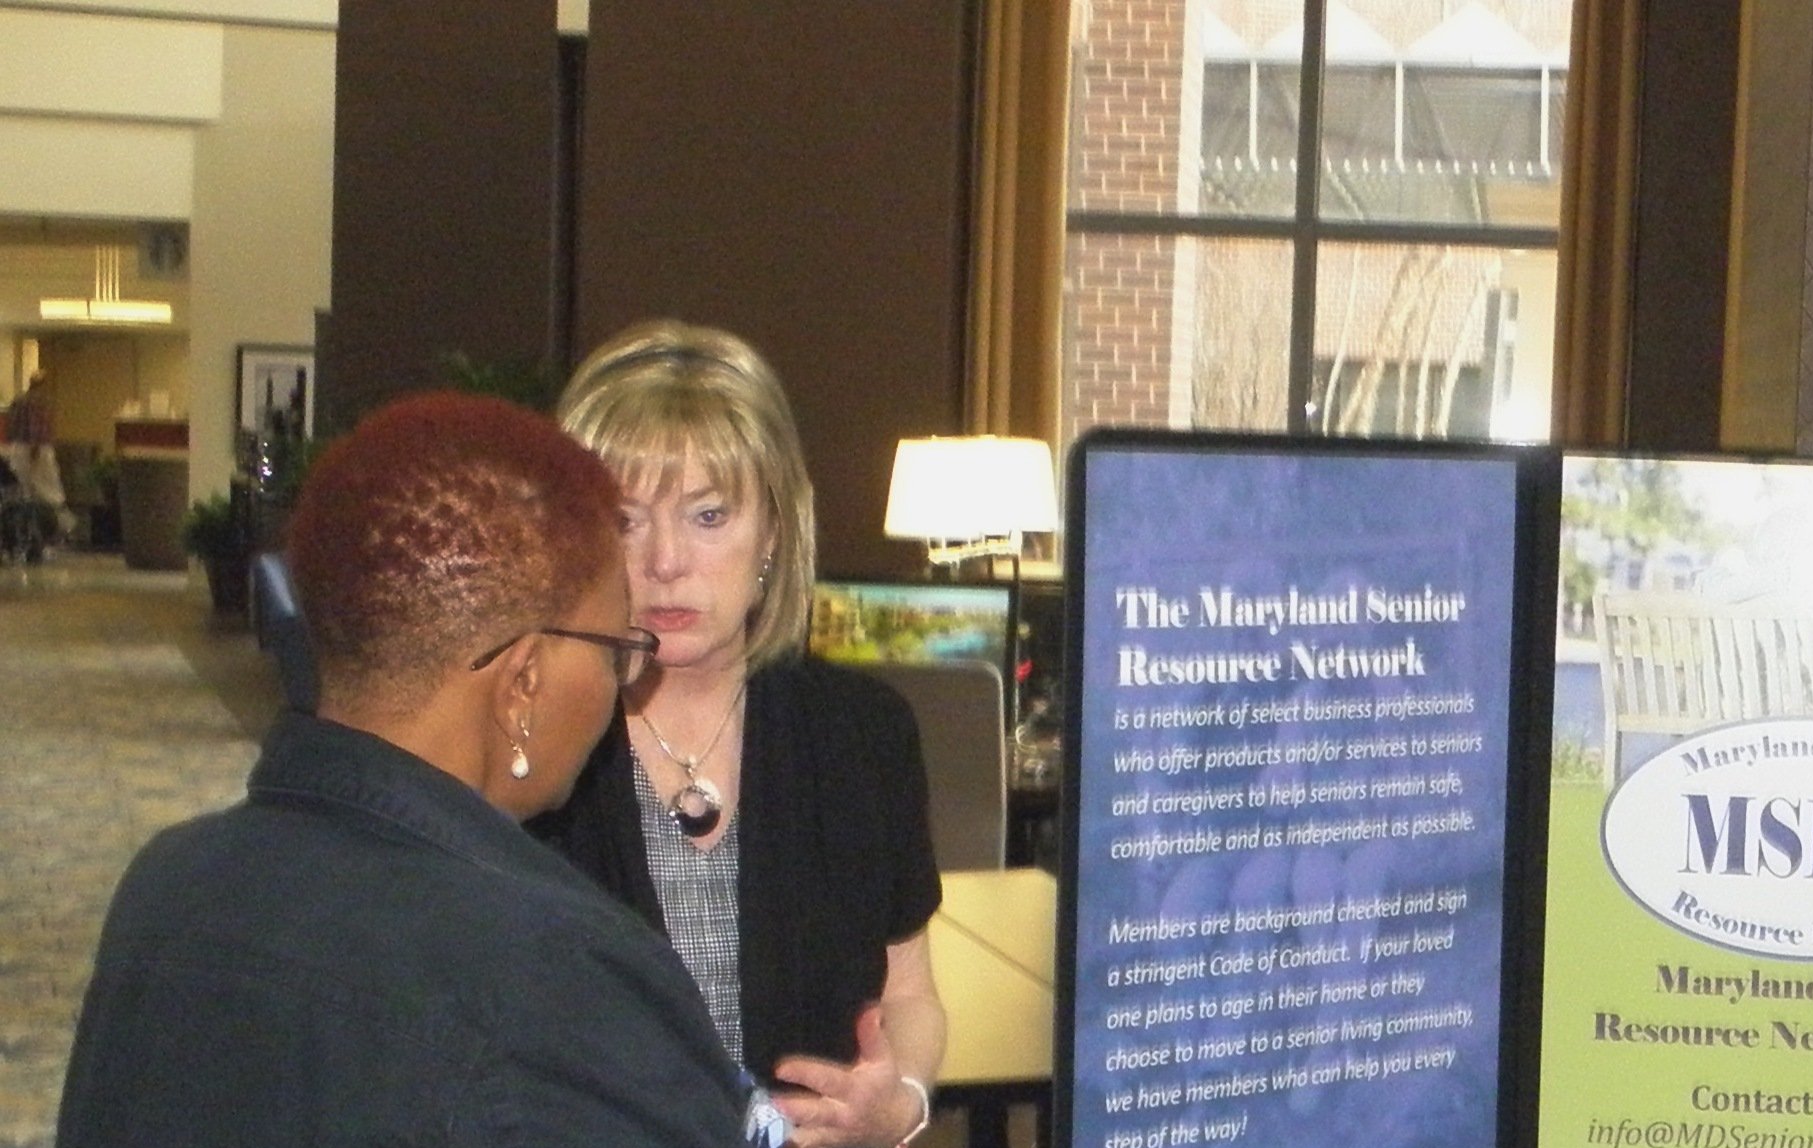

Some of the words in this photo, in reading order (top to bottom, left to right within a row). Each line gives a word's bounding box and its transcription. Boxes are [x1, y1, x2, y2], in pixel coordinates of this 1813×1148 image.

[1115, 589, 1189, 629] The
[1199, 585, 1358, 634] Maryland
[1365, 583, 1465, 623] Senior
[1119, 650, 1281, 687] Resource
[1290, 639, 1424, 680] Network
[1149, 702, 1225, 727] network
[1229, 701, 1247, 729] of
[1251, 700, 1300, 722] select
[1303, 697, 1372, 720] business
[1375, 690, 1475, 722] professionals
[1114, 748, 1156, 773] who
[1158, 744, 1202, 774] offer
[1203, 742, 1280, 774] products
[1285, 738, 1341, 766] and/or
[1346, 735, 1407, 758] services
[1410, 736, 1427, 755] to
[1430, 730, 1483, 753] seniors
[1112, 792, 1148, 815] and
[1152, 788, 1244, 816] caregivers
[1247, 788, 1266, 806] to
[1269, 782, 1306, 809] help
[1310, 779, 1366, 802] seniors
[1371, 774, 1425, 798] remain
[1429, 772, 1464, 799] safe,
[1110, 828, 1221, 860] comfortable
[1225, 825, 1260, 849] and
[1286, 817, 1388, 847] independent
[1411, 810, 1476, 841] possible.
[1108, 918, 1197, 944] Members
[1200, 917, 1229, 935] are
[1233, 901, 1333, 934] background
[1337, 895, 1400, 922] checked
[1403, 891, 1433, 915] and
[1436, 889, 1467, 916] sign
[1670, 890, 1804, 946] Resource
[1124, 957, 1205, 985] stringent
[1209, 950, 1254, 975] Code
[1257, 947, 1275, 974] of
[1279, 942, 1352, 967] Conduct.
[1358, 936, 1371, 963] If
[1373, 938, 1408, 962] your
[1412, 927, 1453, 953] loved
[1106, 1009, 1140, 1028] one
[1145, 1000, 1195, 1029] plans
[1198, 998, 1218, 1017] to
[1220, 996, 1253, 1019] age
[1277, 983, 1317, 1008] their
[1320, 981, 1367, 1003] home
[1390, 972, 1424, 998] they
[1105, 1047, 1170, 1071] choose
[1173, 1043, 1194, 1062] to
[1197, 1038, 1245, 1059] move
[1249, 1033, 1269, 1052] to
[1287, 1022, 1337, 1047] senior
[1340, 1015, 1383, 1041] living
[1386, 1005, 1474, 1034] community,
[1593, 1013, 1760, 1048] Resource
[1104, 1094, 1132, 1112] we
[1136, 1086, 1181, 1108] have
[1185, 1074, 1268, 1101] members
[1271, 1065, 1309, 1089] who
[1310, 1065, 1340, 1084] can
[1343, 1055, 1380, 1081] help
[1381, 1056, 1410, 1080] you
[1413, 1049, 1454, 1071] every
[1169, 1122, 1199, 1145] the
[1203, 1114, 1246, 1143] way!
